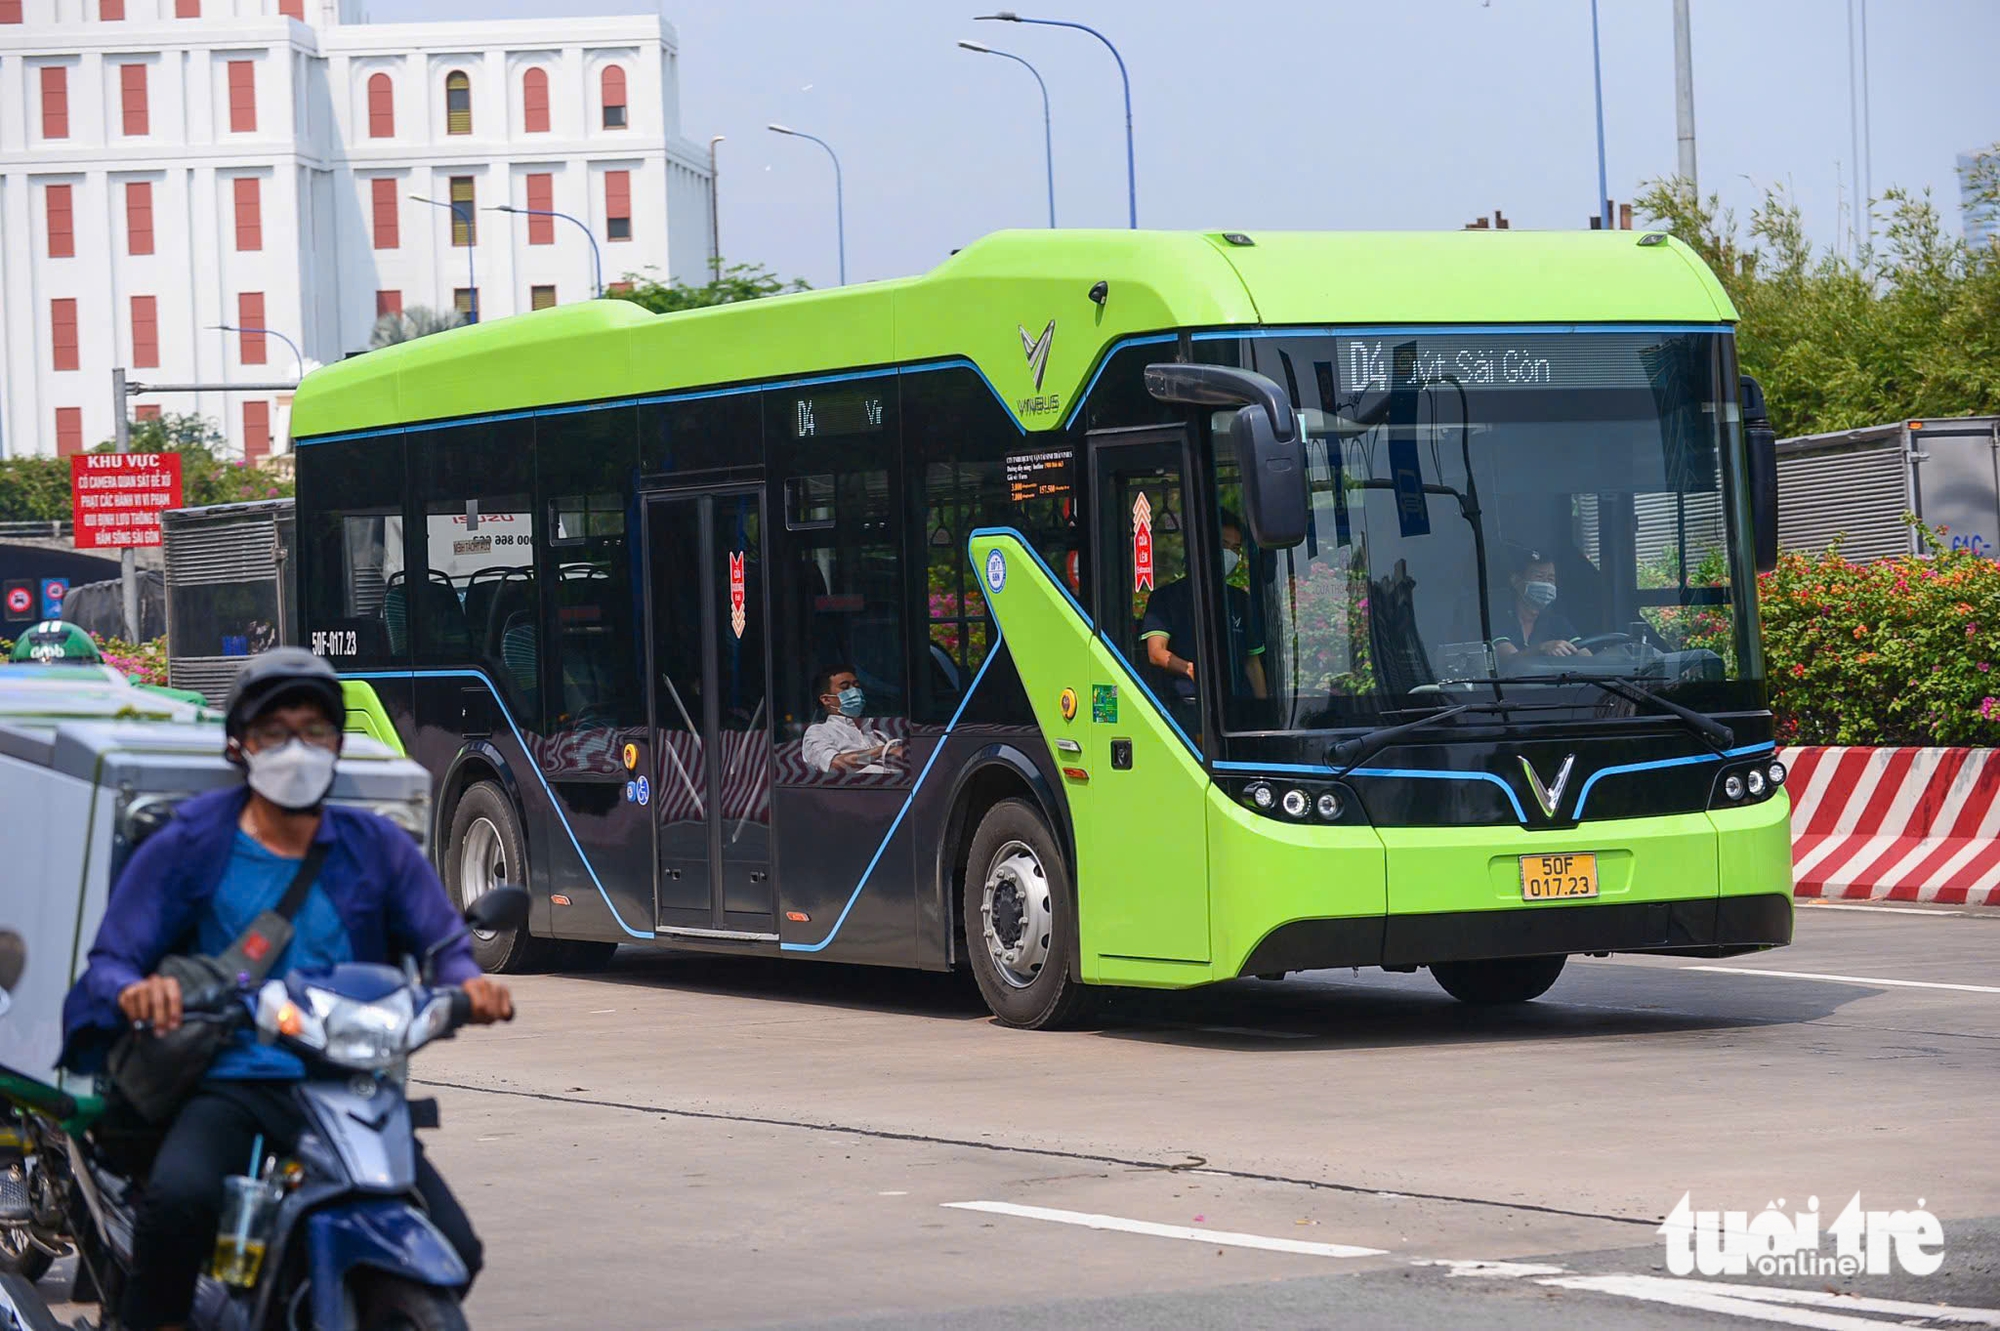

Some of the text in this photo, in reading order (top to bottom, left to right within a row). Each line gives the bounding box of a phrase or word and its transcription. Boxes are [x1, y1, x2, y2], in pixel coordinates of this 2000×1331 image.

[1350, 341, 1387, 391] D4
[1456, 350, 1494, 383] Sài
[1503, 350, 1550, 383] Gòn
[1016, 395, 1060, 414] VINBUS
[798, 400, 815, 436] D4
[87, 454, 160, 471] KHU VỰC
[312, 631, 357, 656] 50F-017.23
[1542, 856, 1573, 875] 50F
[1530, 876, 1589, 897] 017.23
